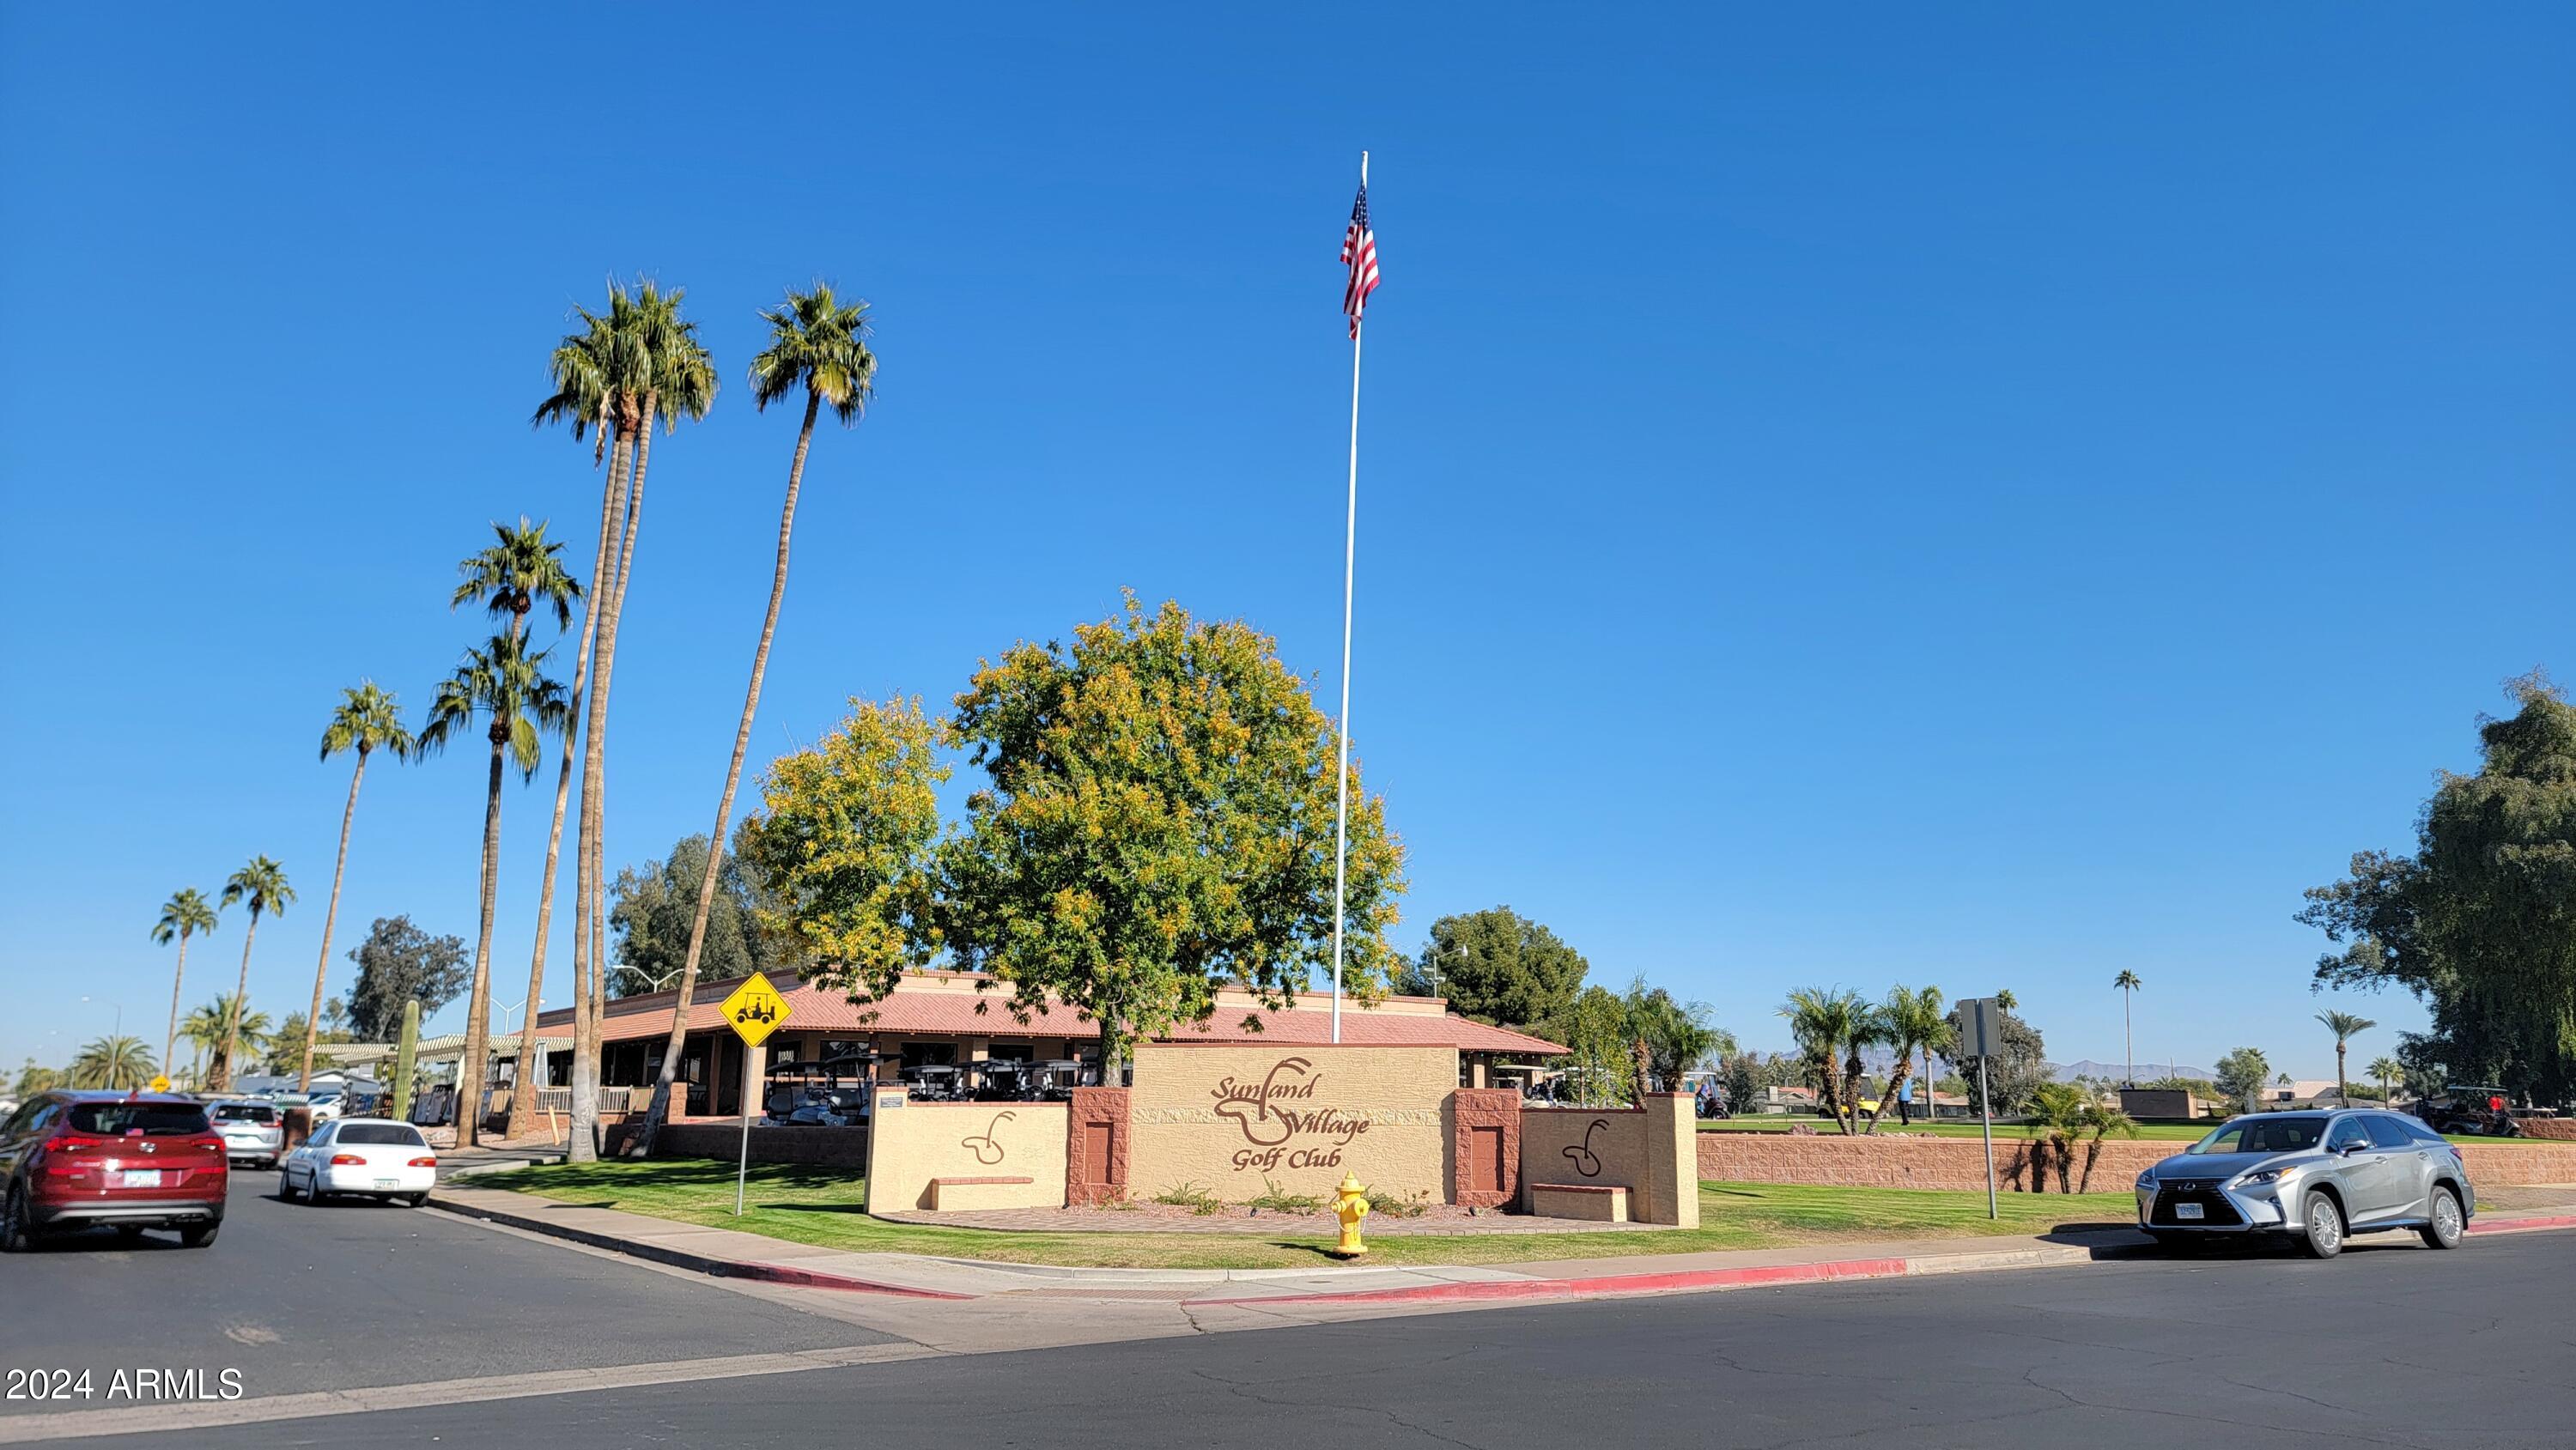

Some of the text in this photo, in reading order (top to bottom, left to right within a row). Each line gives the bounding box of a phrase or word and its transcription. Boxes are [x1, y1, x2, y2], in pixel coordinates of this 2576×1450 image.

[1211, 1058, 1322, 1107] Sunland
[1288, 1108, 1370, 1145] Village
[1232, 1147, 1342, 1173] Golf Club
